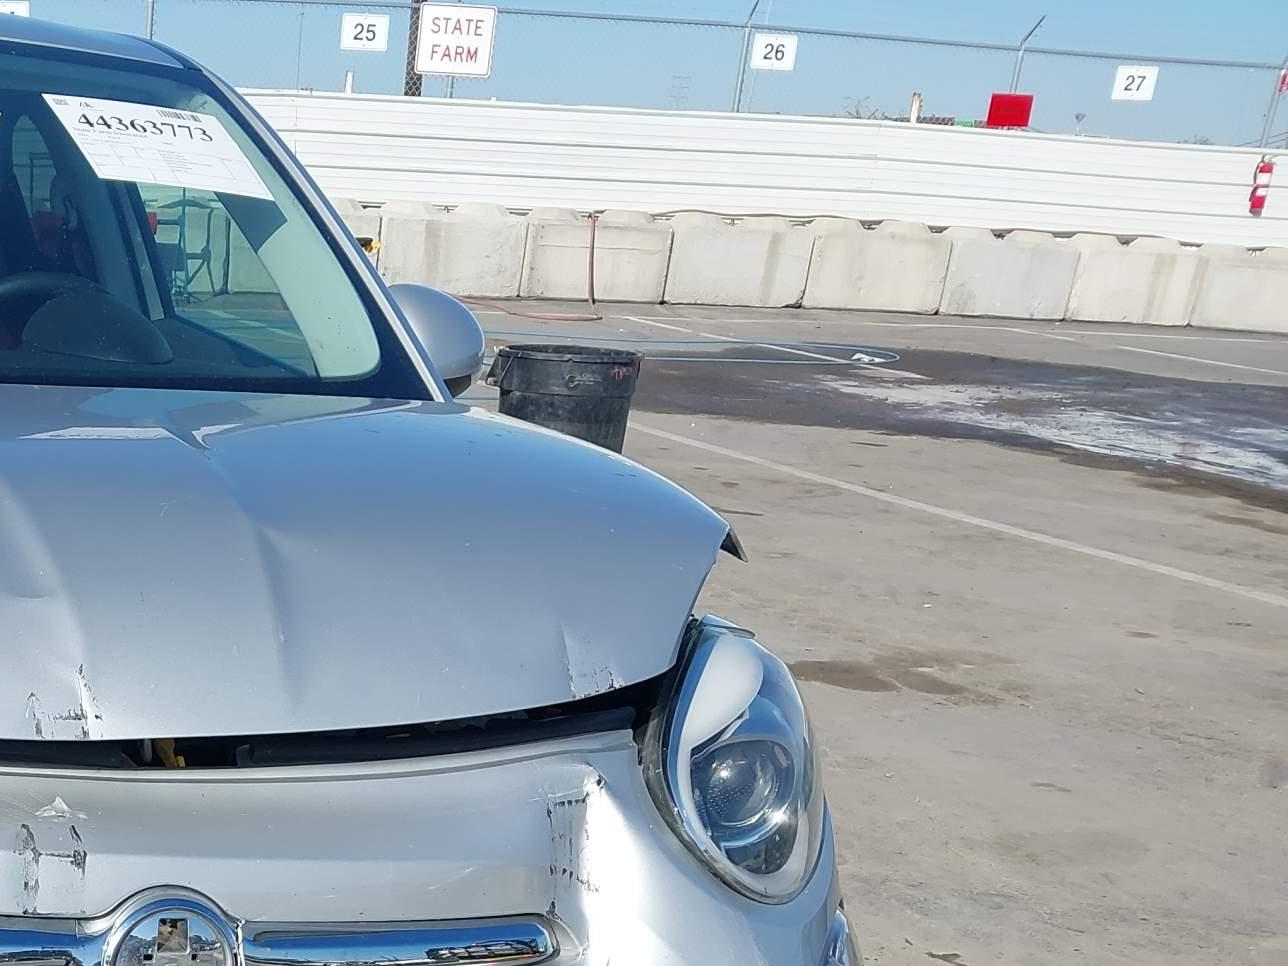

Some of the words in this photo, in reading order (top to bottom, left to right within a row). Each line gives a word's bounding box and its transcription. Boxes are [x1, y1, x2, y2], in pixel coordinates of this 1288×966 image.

[353, 23, 377, 42] 25
[431, 16, 485, 37] STATE
[430, 44, 479, 64] FARM
[763, 42, 786, 62] 26
[1123, 74, 1147, 92] 27
[77, 112, 214, 143] 44363773
